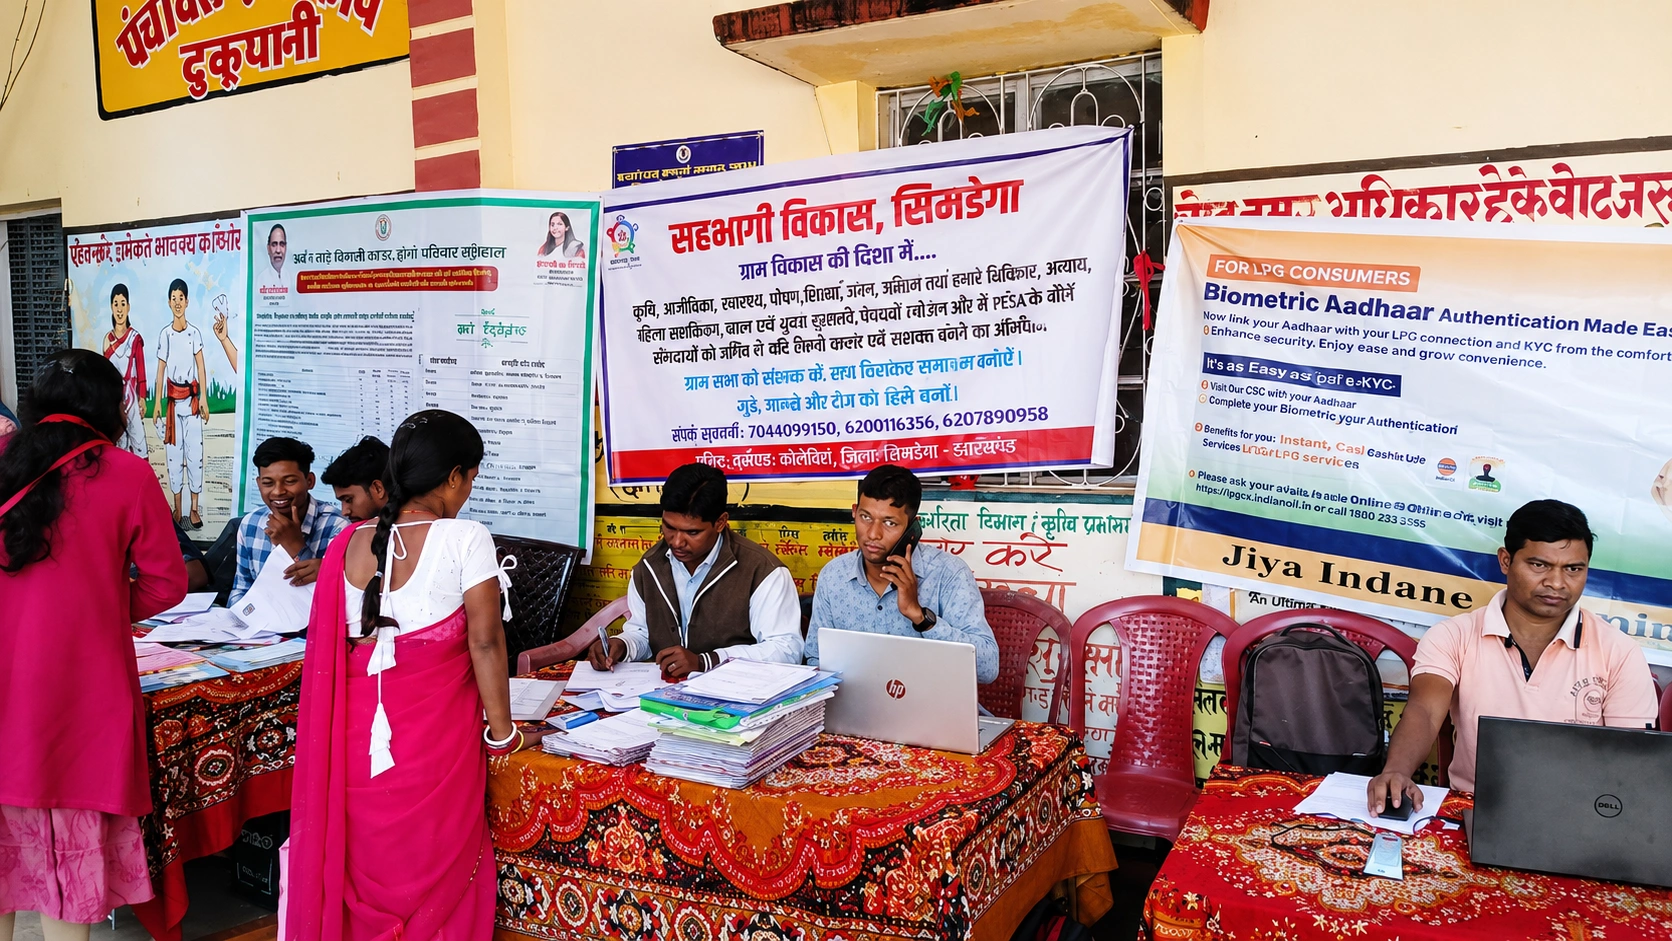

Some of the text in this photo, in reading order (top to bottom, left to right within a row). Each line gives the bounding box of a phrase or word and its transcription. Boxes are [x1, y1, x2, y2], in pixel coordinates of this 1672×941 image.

[668, 176, 1024, 254] सहभागी विकास, सिमडेगा
[738, 262, 767, 281] ग्राम
[771, 253, 823, 275] विकास
[827, 246, 849, 269] की
[853, 243, 893, 267] दिशा
[1214, 259, 1411, 286] FOR LPG CONSUMERS
[1204, 282, 1319, 312] Biometric
[1325, 294, 1434, 321] Aadhaar
[1438, 308, 1579, 332] Authentication
[1583, 318, 1638, 336] Made
[1203, 311, 1672, 362] Now link your Aadhaar with your LPG connection and KYC from the comfort
[1211, 326, 1547, 370] Enhance security. Enjoy ease and grow convenience.
[684, 375, 709, 391] ग्राम
[713, 374, 738, 389] सभा
[742, 368, 759, 386] को
[1207, 357, 1224, 371] It's
[1226, 362, 1244, 373] as
[1248, 361, 1287, 379] Easy
[1208, 395, 1251, 410] Complete
[1253, 402, 1277, 413] your
[1280, 404, 1336, 422] Biometric
[1210, 381, 1357, 410] Visit Our CSC with your Aadhaar
[748, 422, 840, 440] 7044099150,
[845, 415, 939, 434] 6200116356,
[942, 406, 1049, 428] 6207890958
[1203, 424, 1238, 438] Benefits
[1240, 429, 1253, 440] for
[1255, 432, 1276, 443] you:
[1280, 434, 1331, 452] Instant,
[1202, 438, 1241, 452] Services
[1302, 453, 1359, 470] services
[1197, 470, 1228, 484] Please
[1229, 477, 1247, 488] ask
[1249, 481, 1275, 492] your
[1350, 495, 1391, 510] Online
[1478, 515, 1504, 529] visit
[1313, 504, 1326, 513] or
[1328, 505, 1347, 517] call
[1377, 512, 1398, 525] 233
[1222, 544, 1473, 610] Jiya Indane
[889, 679, 904, 700] hp
